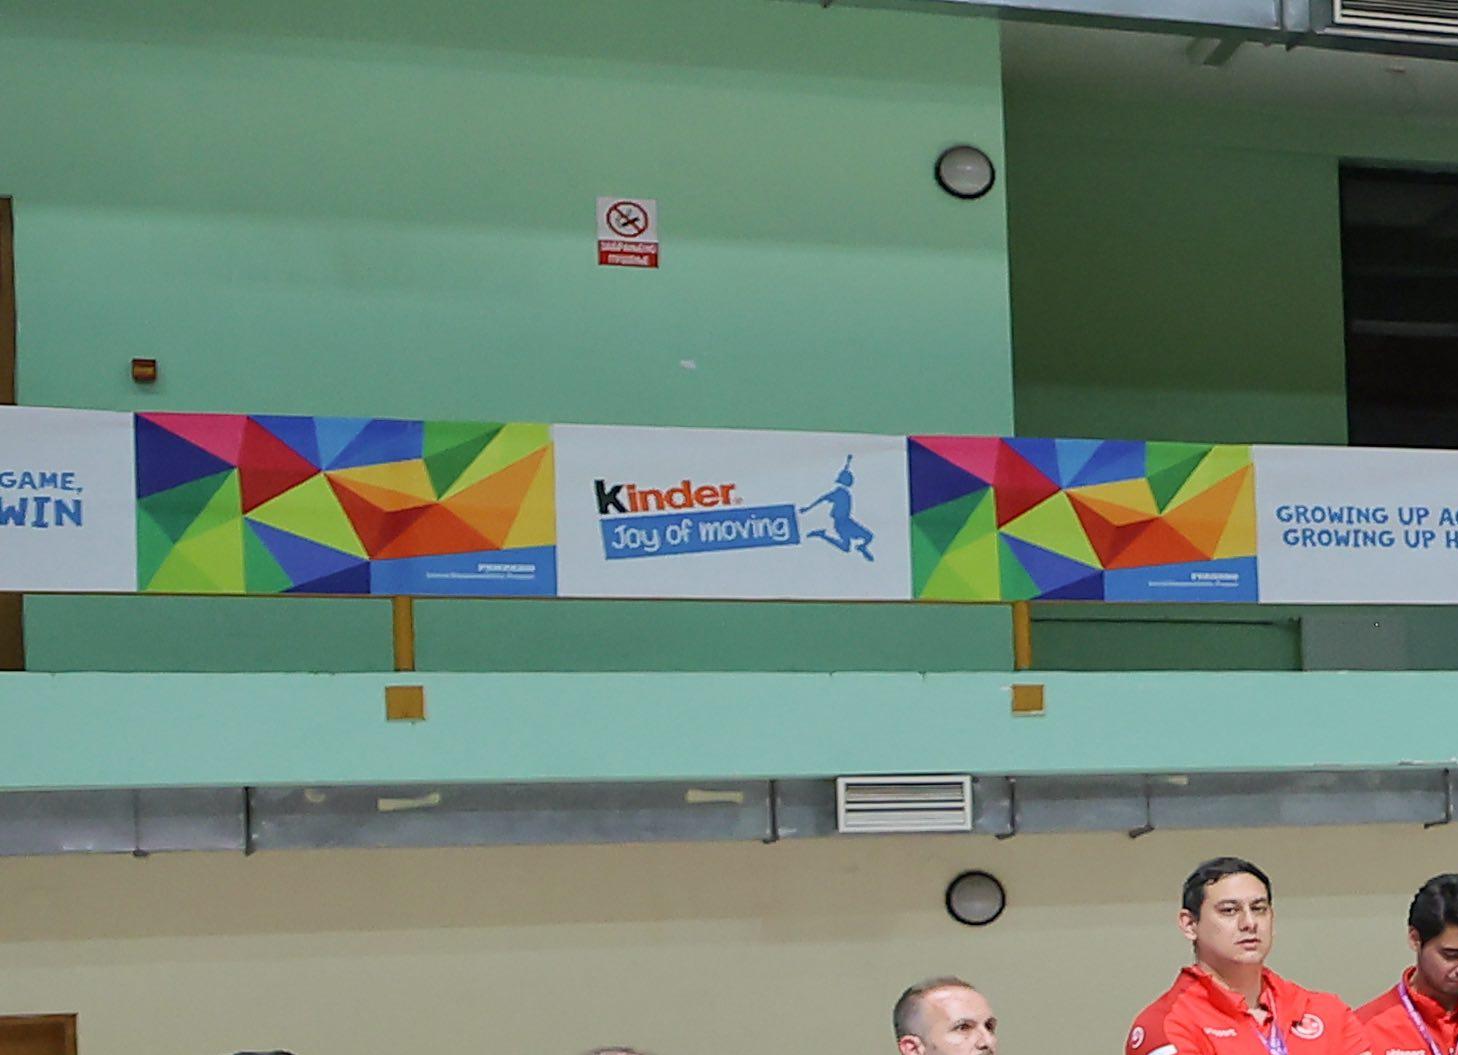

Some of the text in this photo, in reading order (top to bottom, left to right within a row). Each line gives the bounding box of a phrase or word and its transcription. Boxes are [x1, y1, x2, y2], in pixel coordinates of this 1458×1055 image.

[0, 496, 83, 529] WIN
[1275, 504, 1389, 525] GROWING
[1398, 506, 1430, 526] UP
[610, 514, 792, 552] Joy of moving
[1282, 528, 1395, 548] GROWING
[1404, 530, 1436, 549] UP
